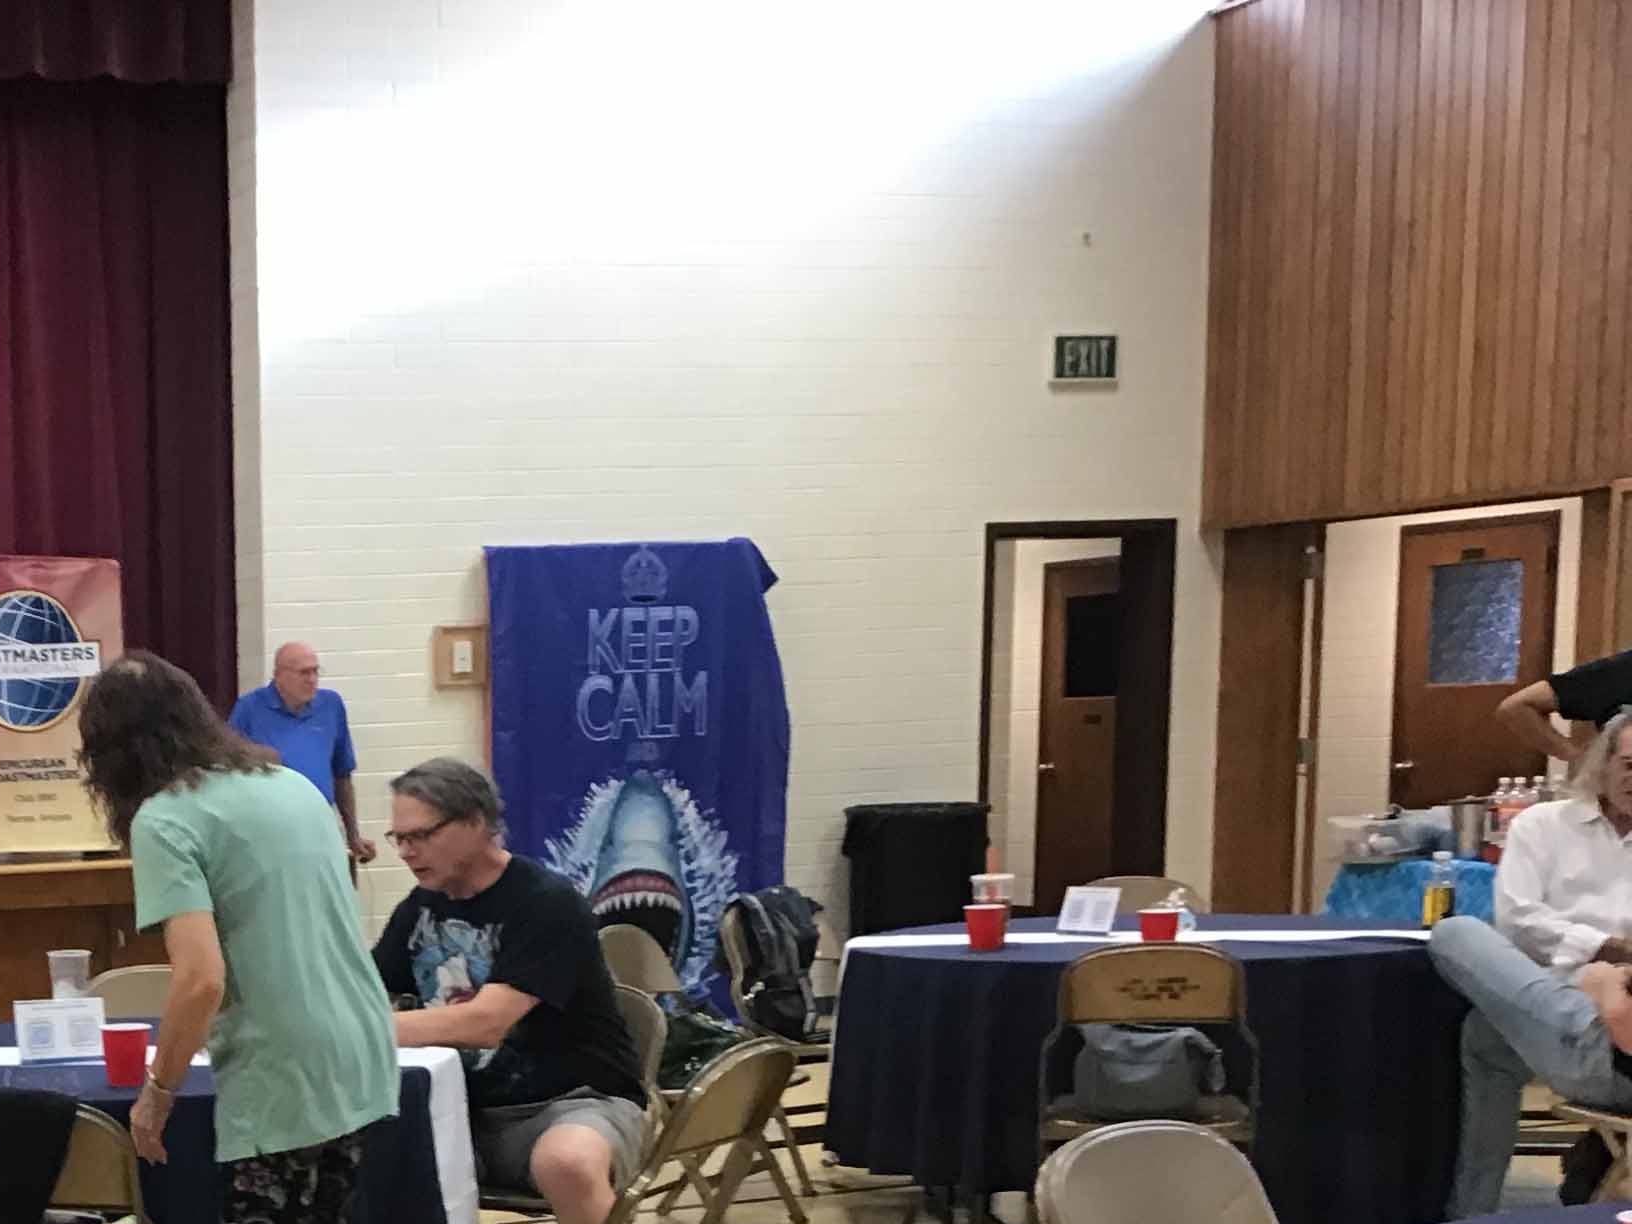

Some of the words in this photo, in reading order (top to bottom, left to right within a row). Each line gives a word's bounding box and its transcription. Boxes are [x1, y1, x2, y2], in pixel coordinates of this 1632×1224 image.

[1064, 341, 1110, 377] EXIT
[587, 605, 700, 675] KEEP
[575, 670, 708, 742] CALM
